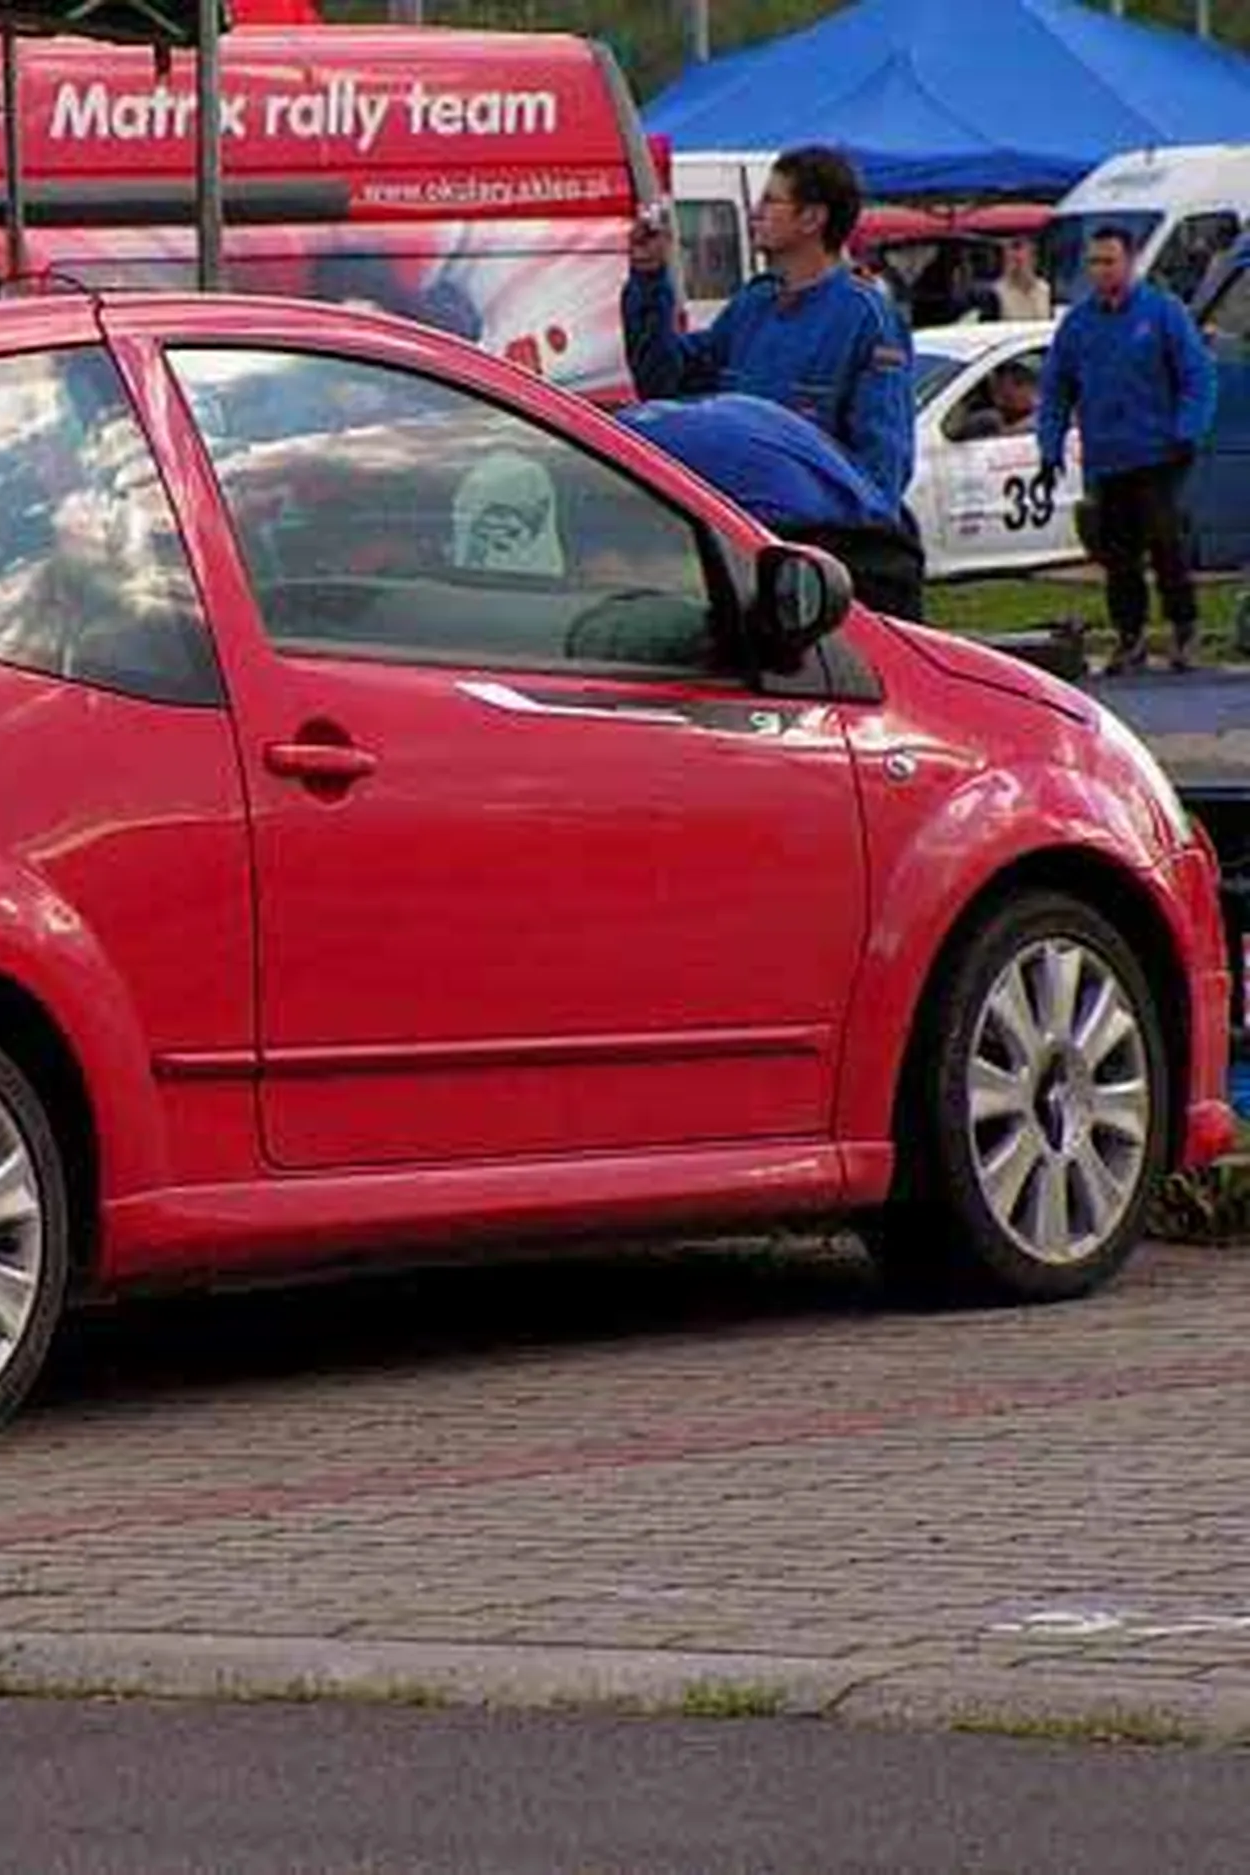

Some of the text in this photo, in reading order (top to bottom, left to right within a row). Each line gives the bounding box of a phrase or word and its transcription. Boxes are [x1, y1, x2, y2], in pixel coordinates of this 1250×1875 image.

[50, 79, 556, 153] Matrx rally team
[1003, 475, 1056, 531] 39
